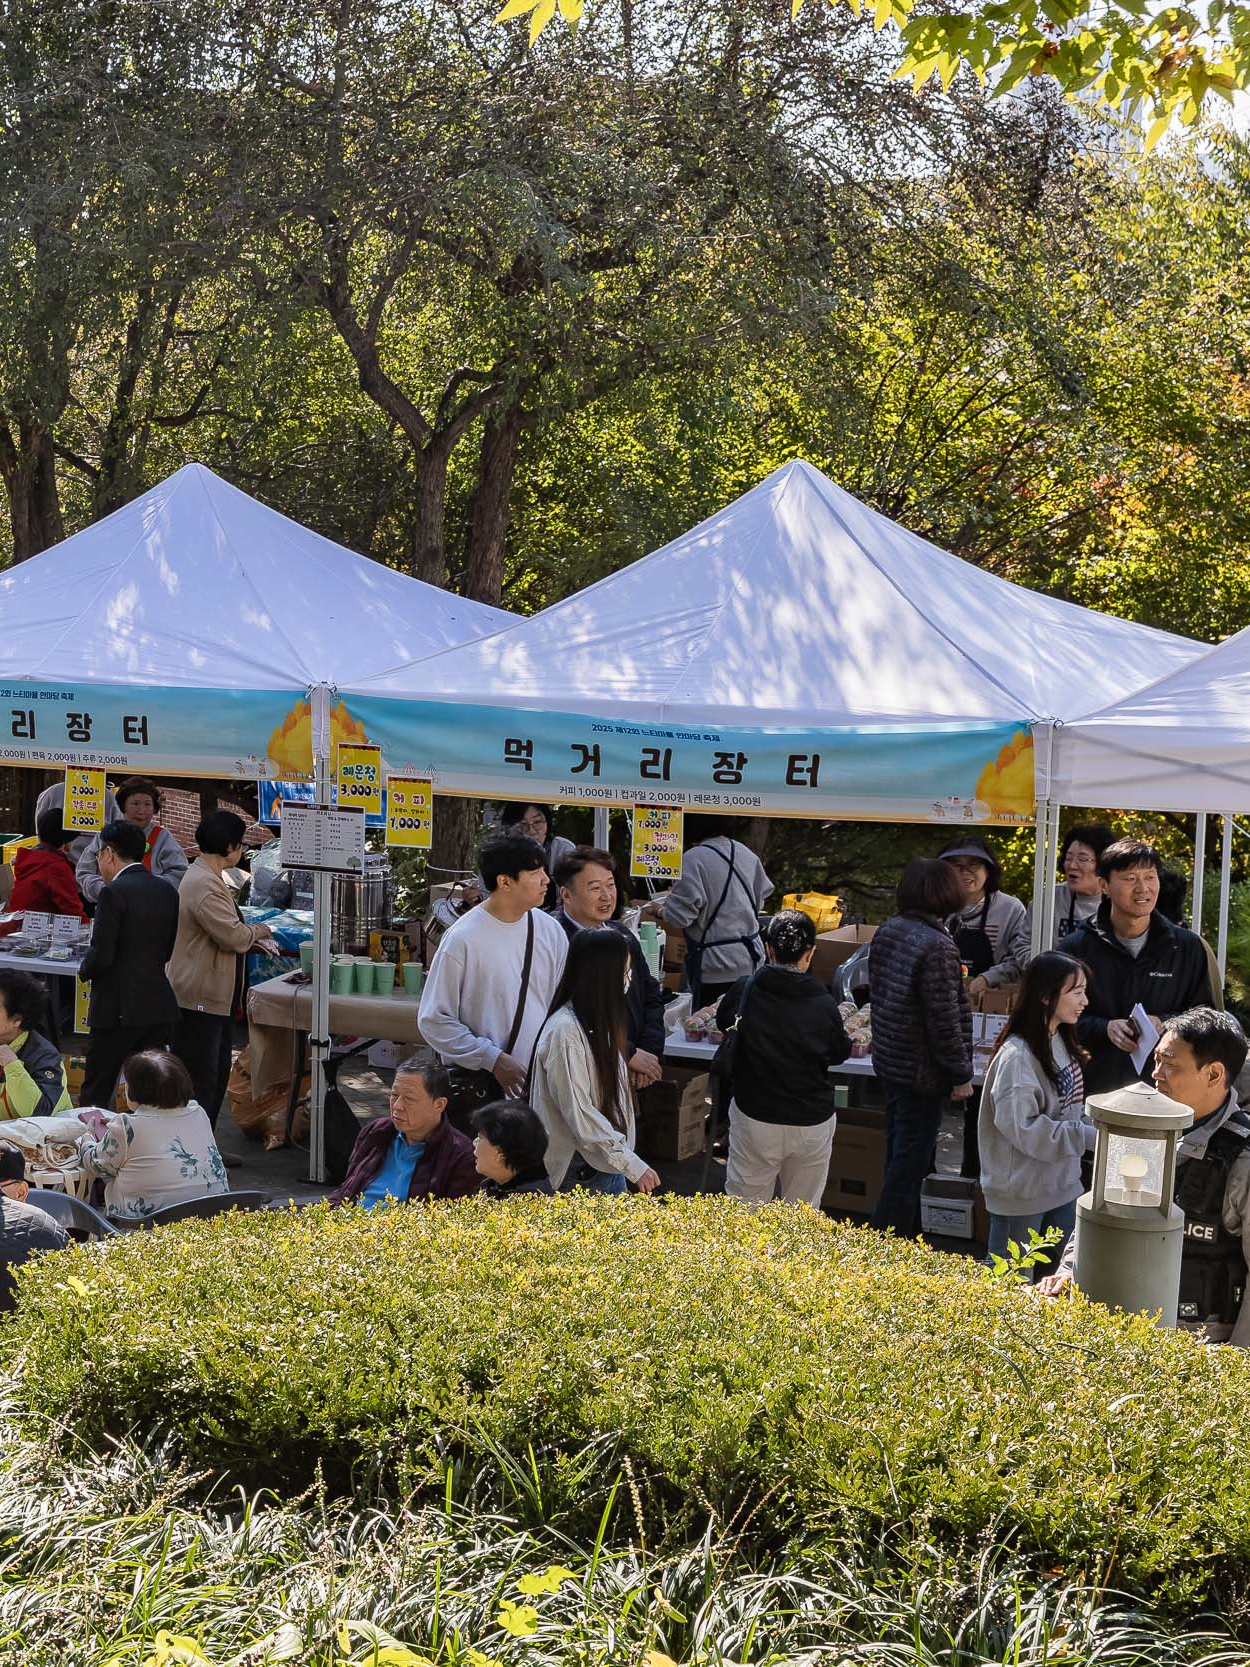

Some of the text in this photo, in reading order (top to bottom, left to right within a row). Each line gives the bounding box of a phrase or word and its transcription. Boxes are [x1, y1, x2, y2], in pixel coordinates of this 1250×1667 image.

[591, 724, 613, 732] 2025
[48, 752, 76, 762] 2,000원
[98, 756, 128, 765] 2,000원
[342, 764, 376, 782] 레몬청
[560, 786, 761, 806] 커피 1,000원 컵과일 2,000원 레몬청 3,000원
[1183, 1223, 1214, 1240] ICE
